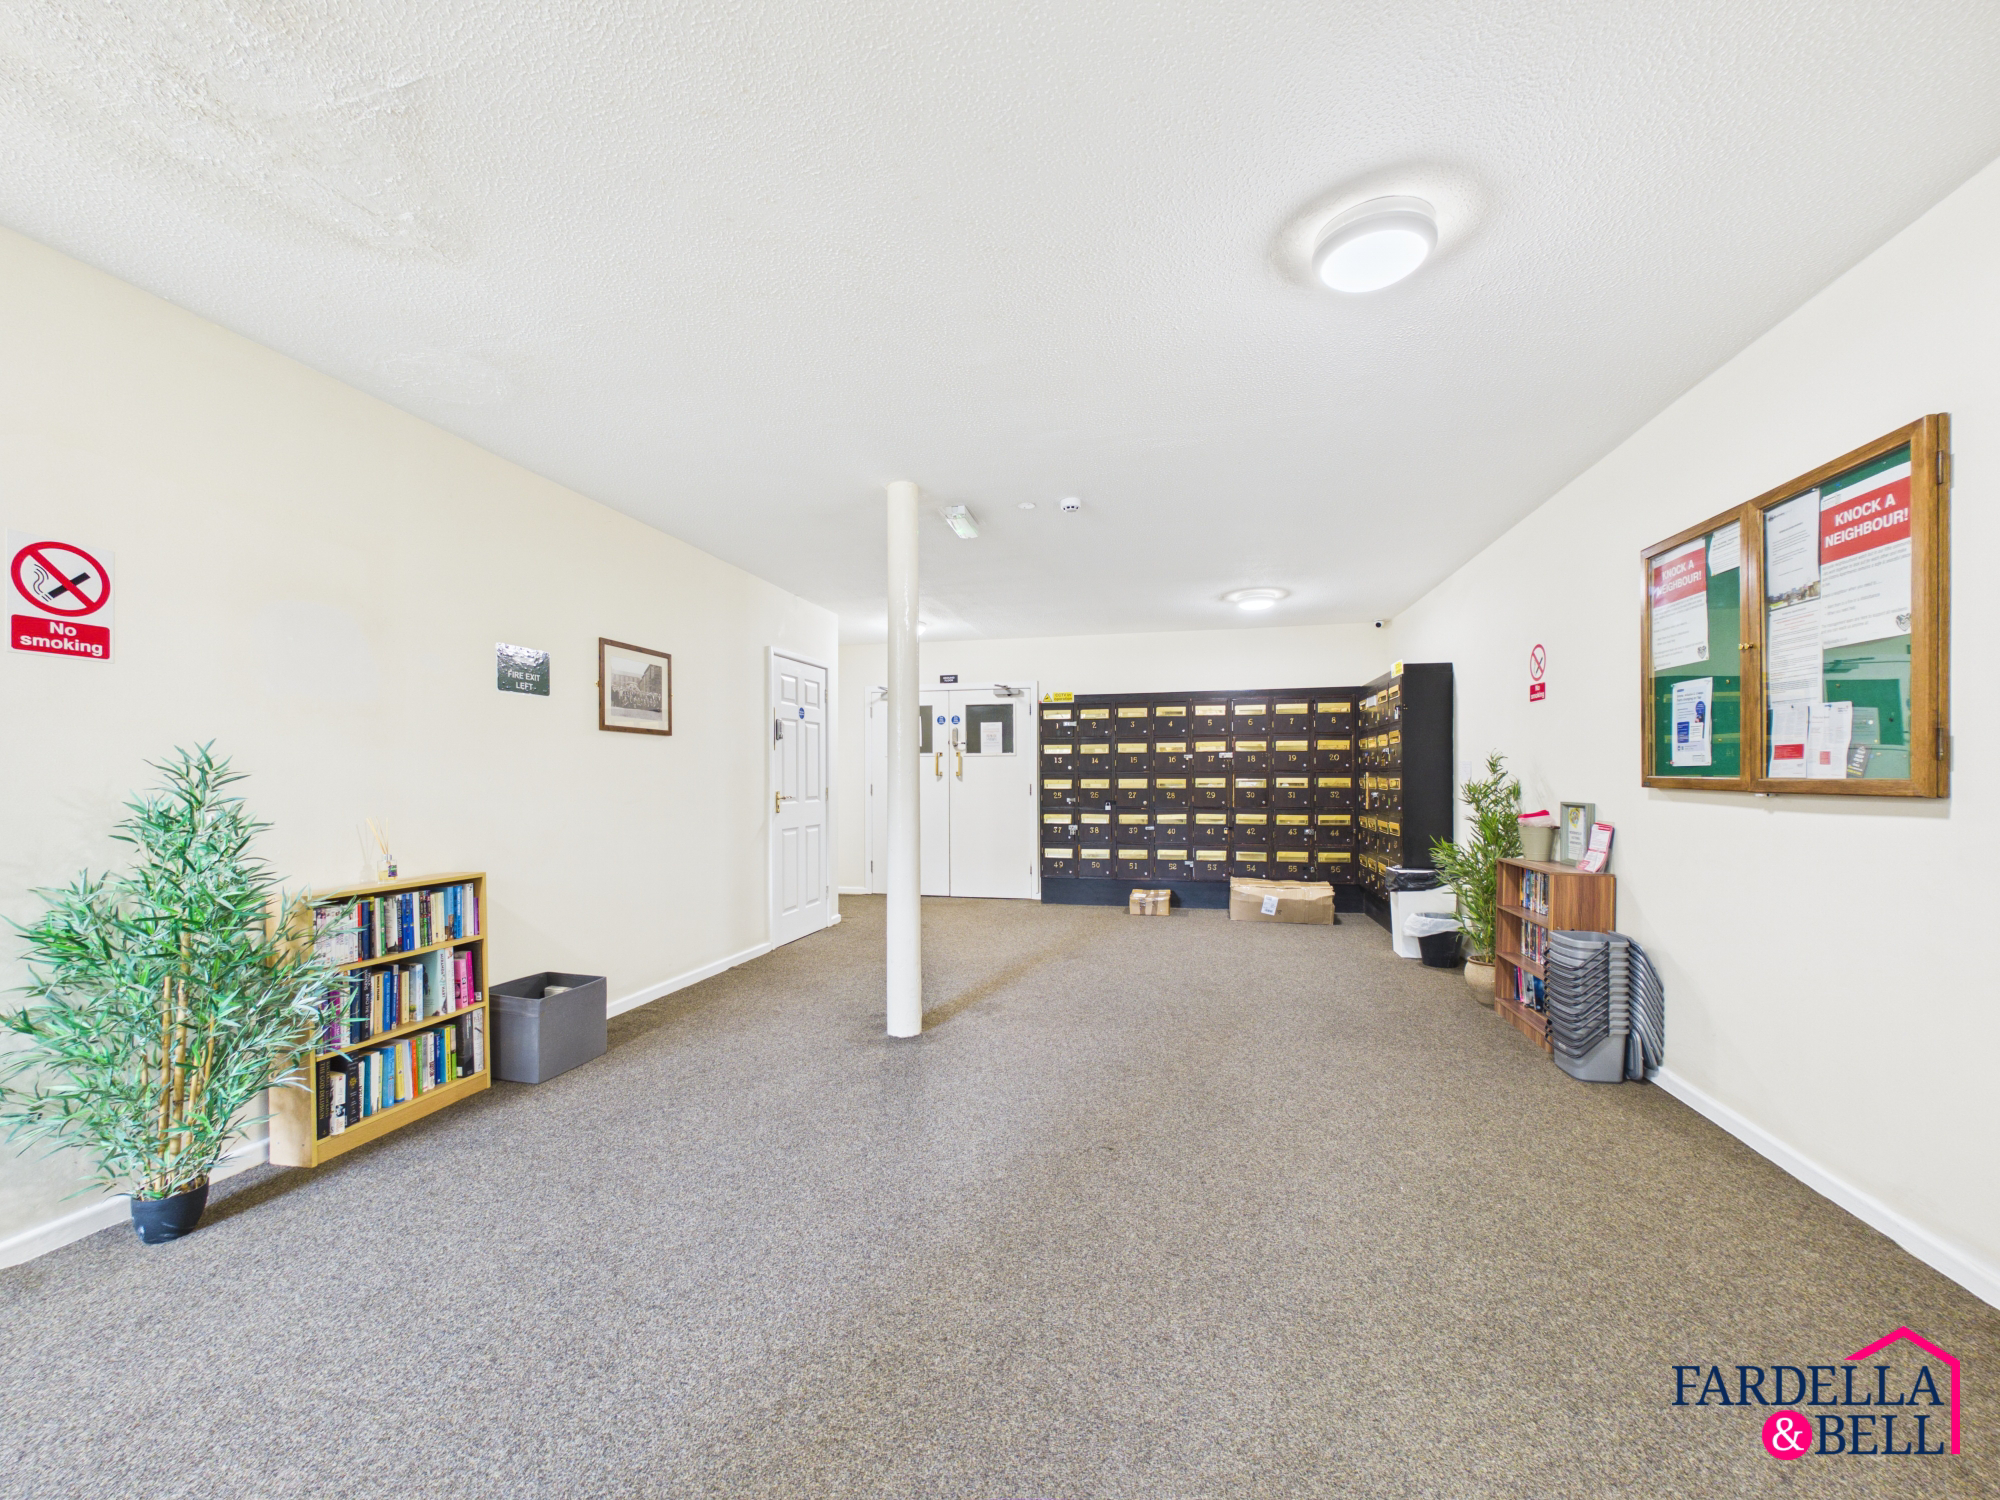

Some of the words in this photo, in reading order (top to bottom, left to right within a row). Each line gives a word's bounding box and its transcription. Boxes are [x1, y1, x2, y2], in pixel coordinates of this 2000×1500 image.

[1835, 498, 1881, 526] KNOCK
[1885, 494, 1896, 508] A
[1824, 508, 1908, 548] NEIGHBOUR!
[1662, 562, 1686, 580] KNOCK
[1688, 560, 1694, 570] A
[50, 622, 76, 636] No
[20, 635, 102, 656] smoking
[508, 670, 524, 680] FIRE
[525, 672, 541, 682] EXIT
[516, 681, 534, 690] LEFT
